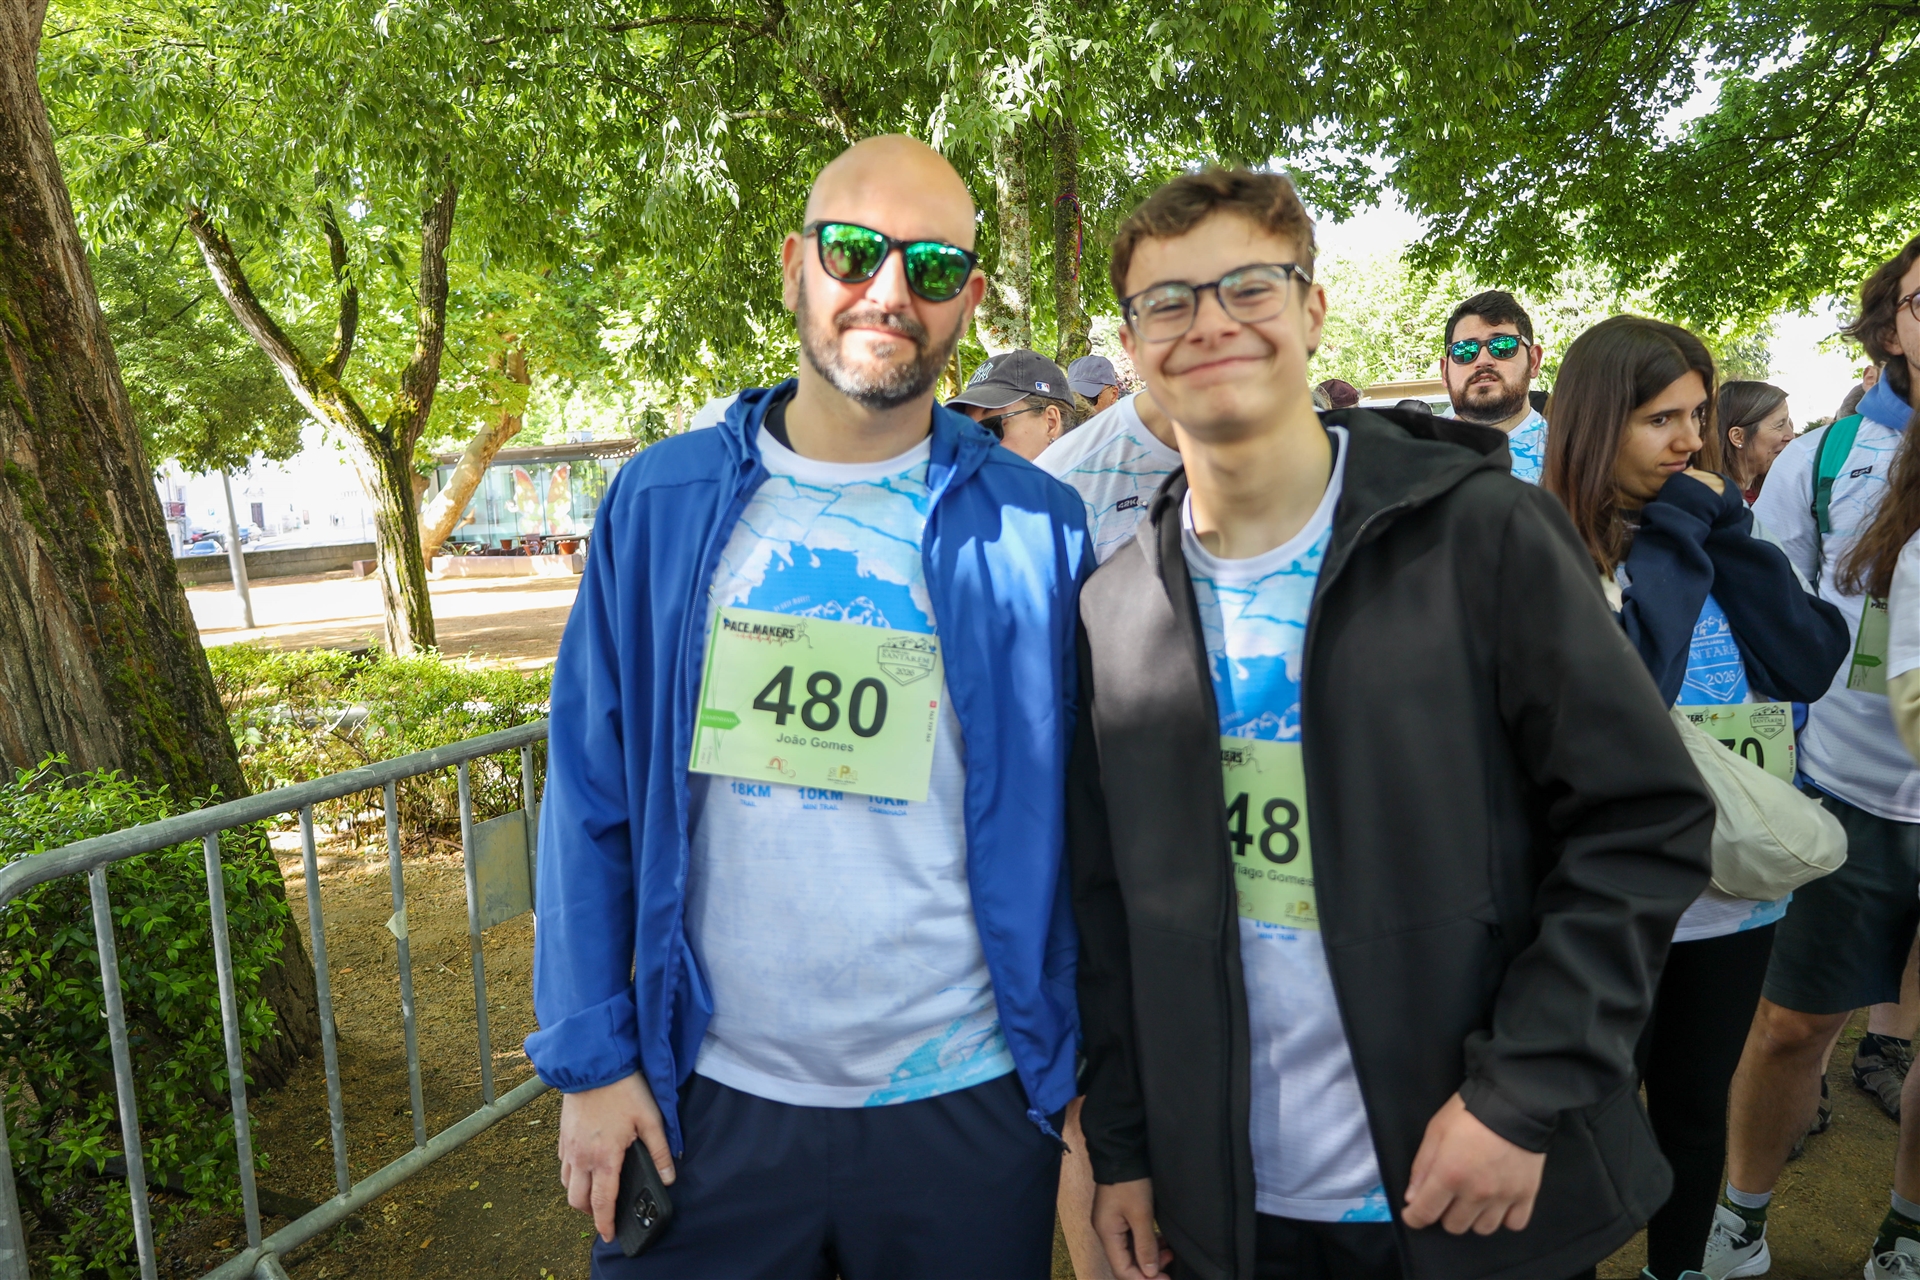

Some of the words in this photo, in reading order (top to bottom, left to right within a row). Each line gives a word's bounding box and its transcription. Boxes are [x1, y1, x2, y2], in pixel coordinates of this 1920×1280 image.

[724, 619, 750, 633] PACE
[752, 624, 795, 640] MAKERS
[1706, 670, 1736, 685] 2026
[752, 665, 888, 738] 480
[776, 733, 807, 746] João
[810, 737, 854, 752] Gomes
[731, 781, 771, 798] 18KM
[798, 787, 843, 801] 10KM
[819, 803, 840, 811] TRAIL
[1267, 869, 1314, 887] Gomes
